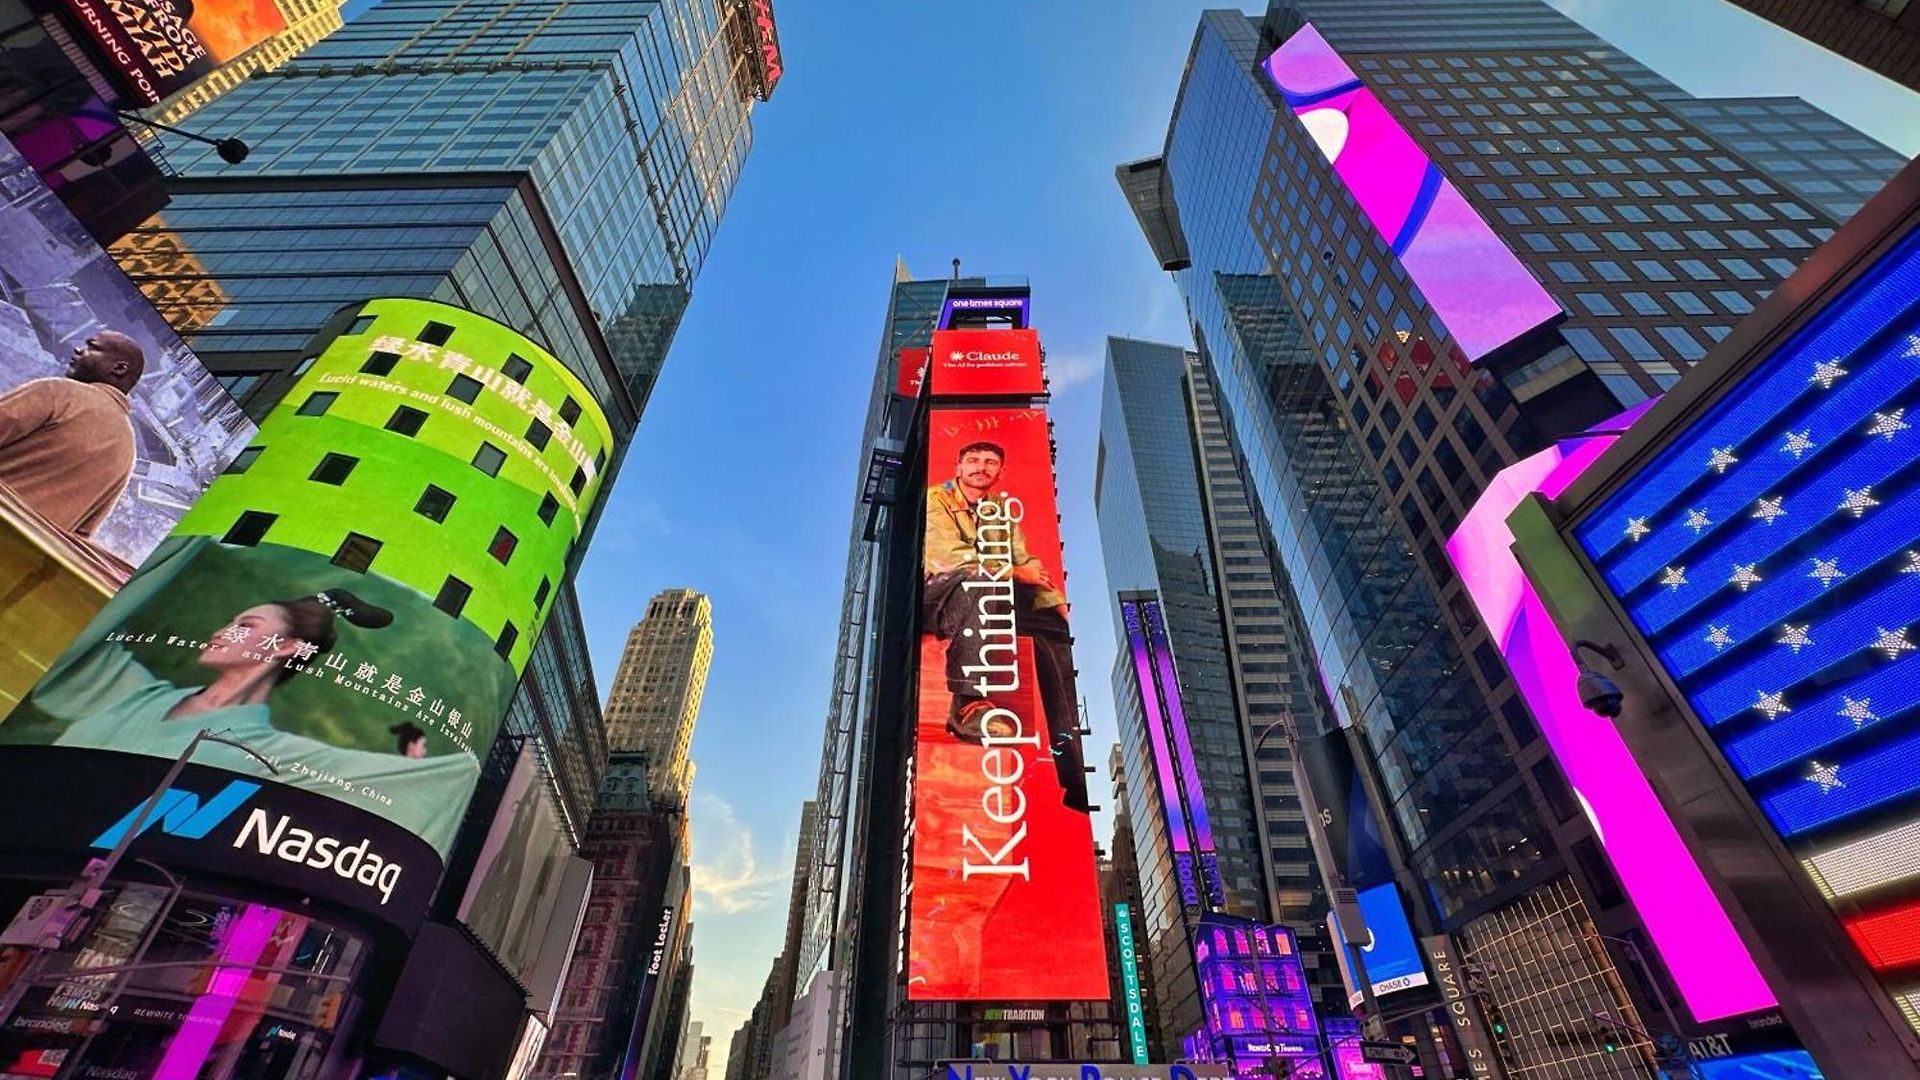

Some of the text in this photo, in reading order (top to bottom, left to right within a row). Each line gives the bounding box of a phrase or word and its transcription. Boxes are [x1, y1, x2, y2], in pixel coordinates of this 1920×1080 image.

[121, 0, 185, 71] AVID
[160, 0, 207, 59] SAGE
[952, 299, 1024, 309] one times square
[966, 351, 1020, 361] Claude
[318, 372, 357, 384] Lucid
[359, 376, 409, 395] waters
[409, 388, 450, 405] and
[440, 399, 473, 419] lush
[472, 415, 534, 461] mountains
[104, 631, 158, 643] Lucid
[165, 635, 231, 653] Waters
[283, 659, 325, 679] Lush
[333, 674, 410, 713] Mountains
[414, 709, 436, 727] Are
[220, 623, 474, 740] 绿水青山就是金山银山
[962, 490, 1041, 882] Keep thinking.
[360, 785, 394, 807] China
[232, 807, 402, 905] Nasdaq
[647, 908, 672, 976] Foot Locker
[79, 1000, 119, 1015] Nasq
[1119, 922, 1145, 1058] SCOTTSDALE
[1433, 950, 1471, 1027] SQUARE
[1687, 1033, 1734, 1060] AT&T
